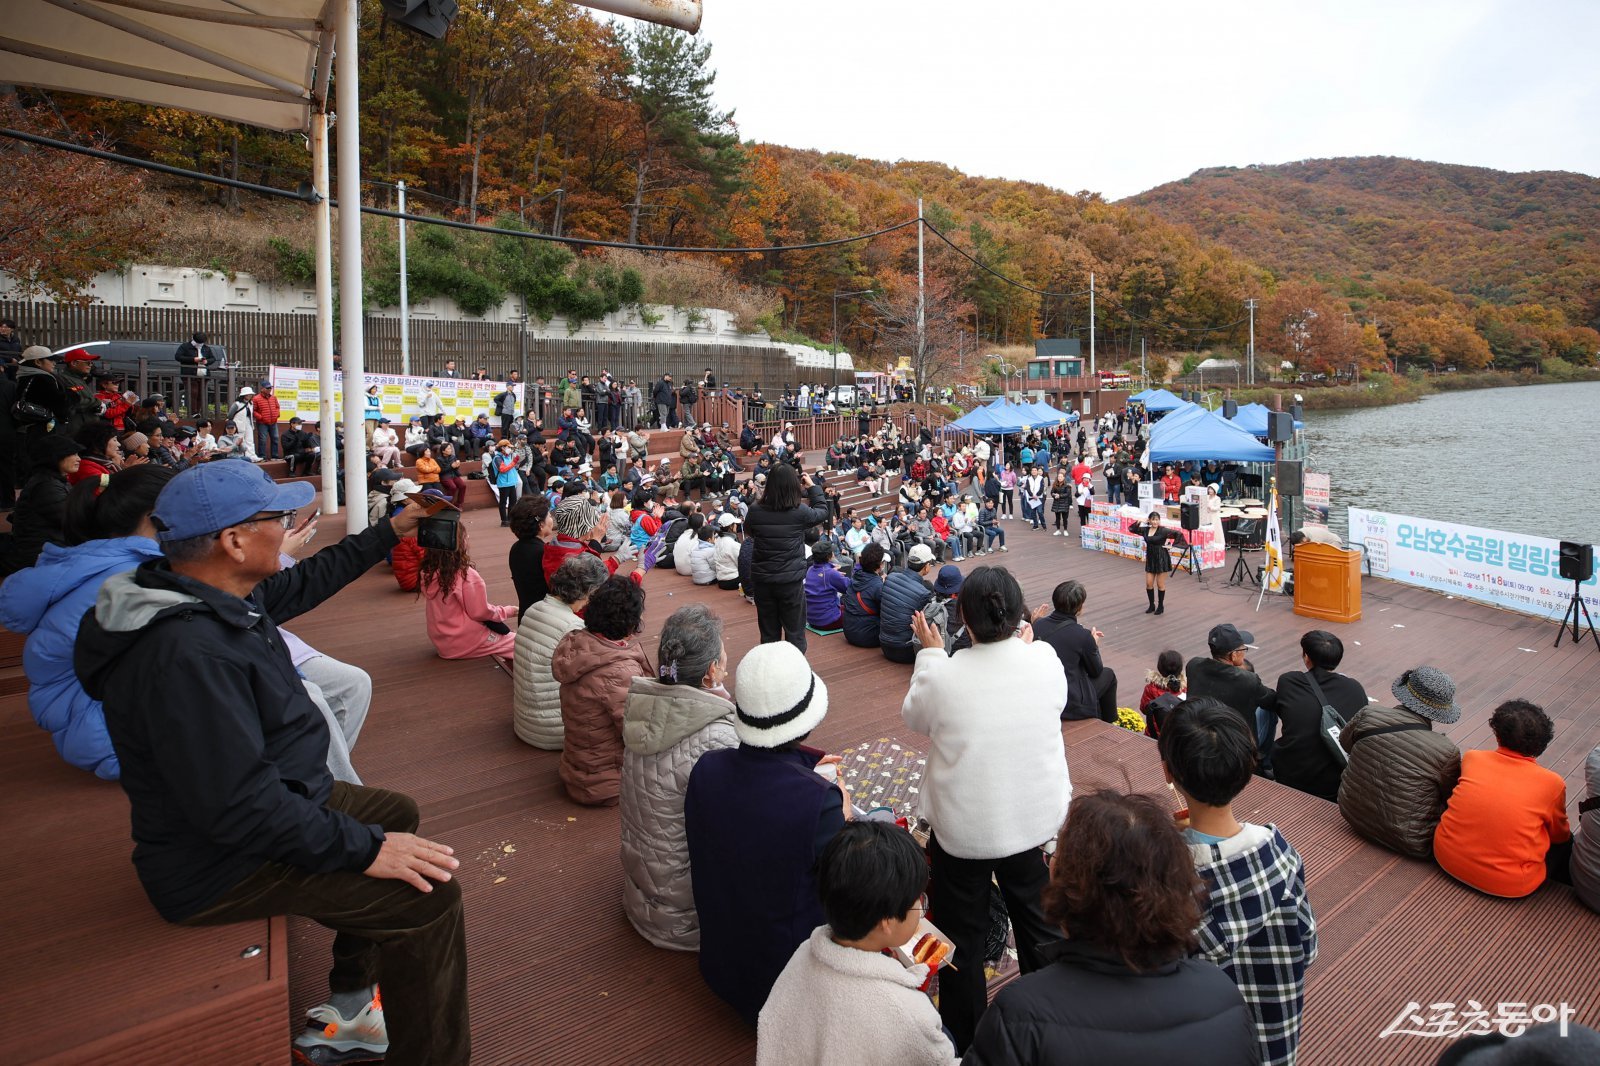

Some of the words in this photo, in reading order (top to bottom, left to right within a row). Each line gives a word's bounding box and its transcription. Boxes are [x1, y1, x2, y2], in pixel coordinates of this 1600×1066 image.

[364, 375, 396, 385] 호수공원
[1395, 523, 1505, 567] 오남호수공원
[1463, 571, 1481, 581] 2025년
[1482, 573, 1496, 584] 11월
[1497, 576, 1517, 589] 8일(토)
[1517, 583, 1534, 593] 09:00
[1540, 587, 1551, 596] 장소
[1536, 599, 1553, 610] 오남읍
